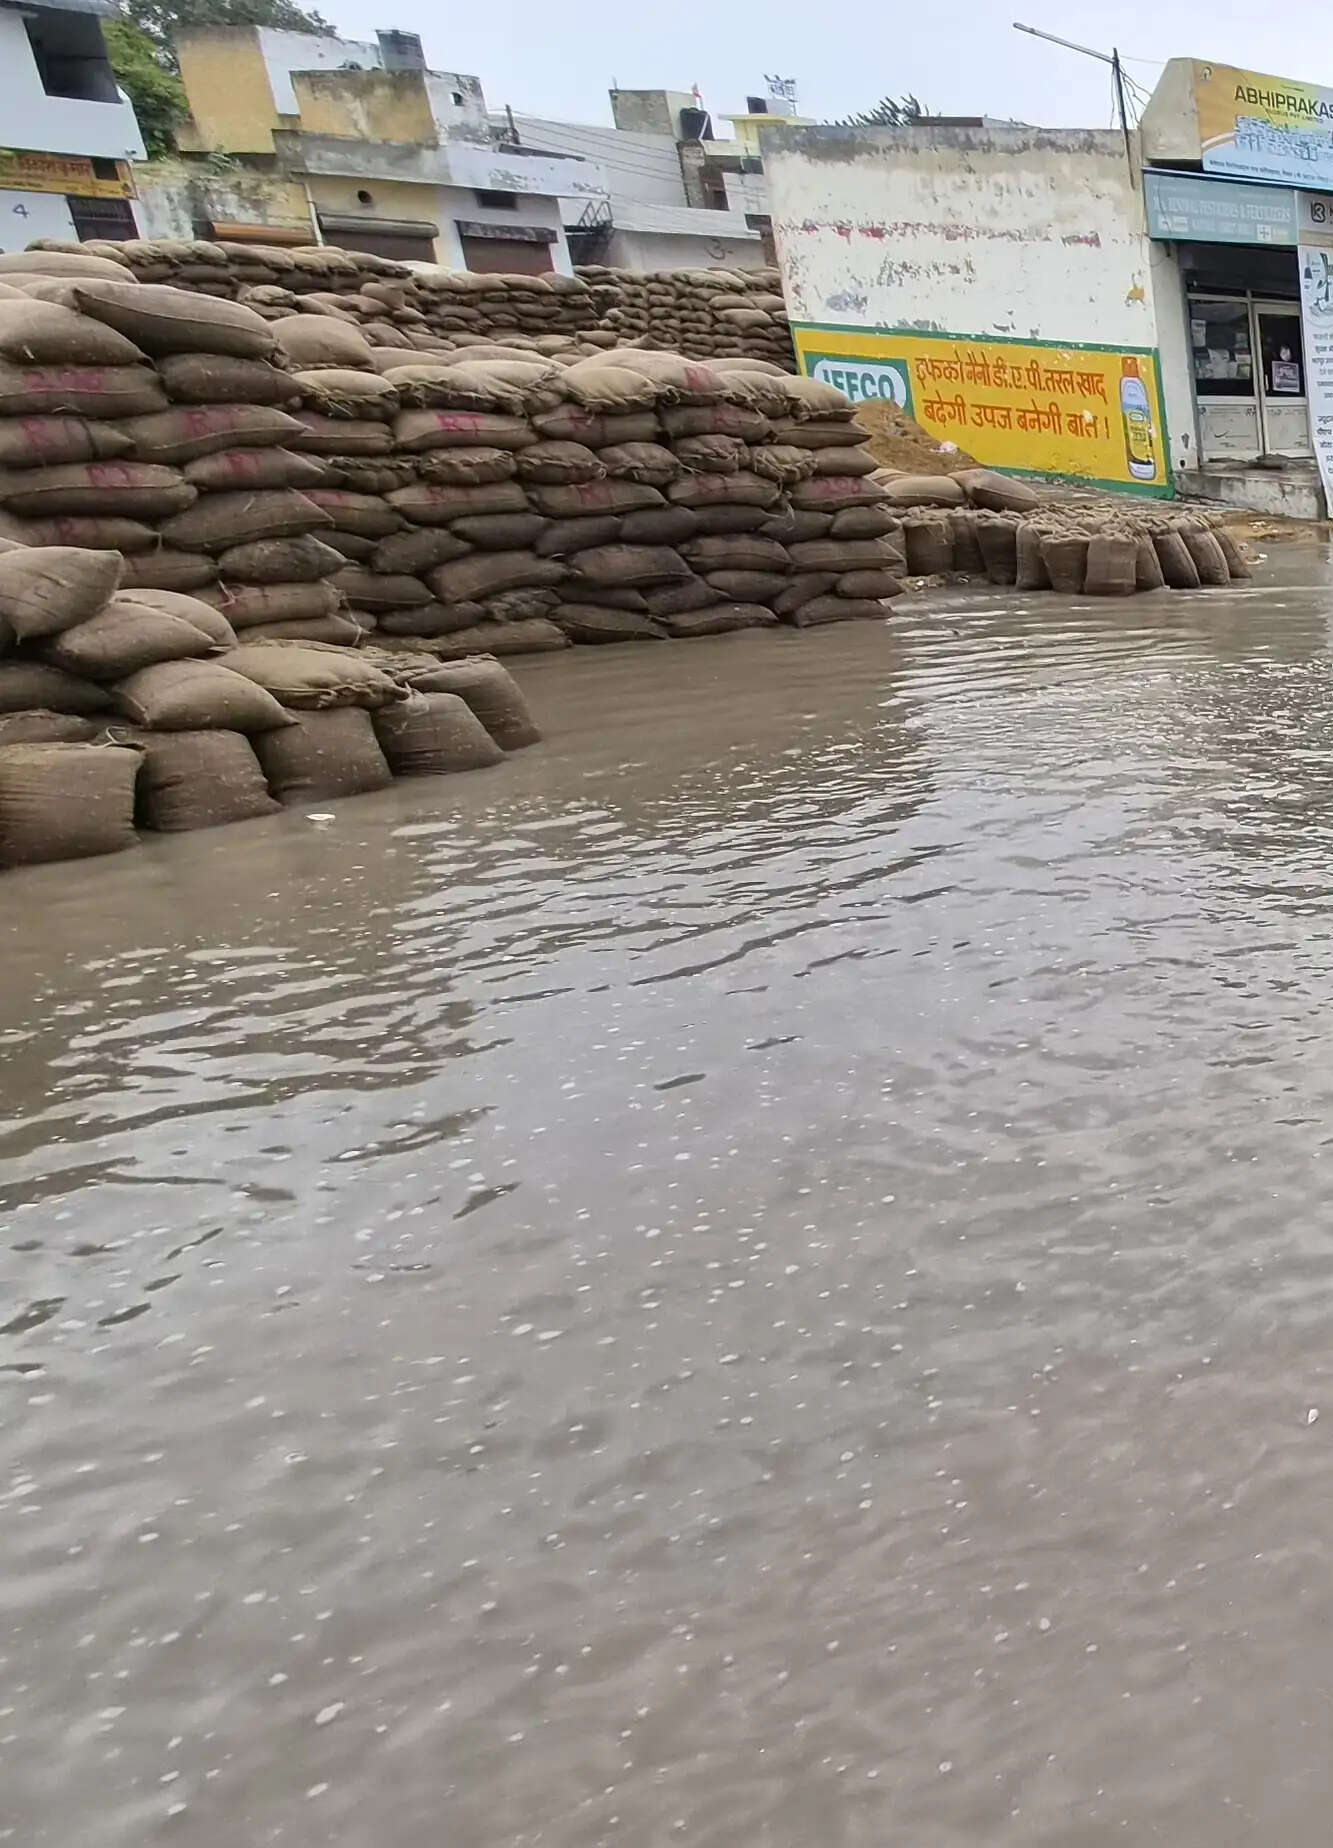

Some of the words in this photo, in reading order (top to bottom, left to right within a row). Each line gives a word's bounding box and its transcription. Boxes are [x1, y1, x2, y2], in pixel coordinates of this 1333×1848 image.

[822, 368, 896, 401] IFFCO
[914, 350, 965, 392] इफको
[966, 350, 991, 387] नैनो
[1077, 370, 1109, 405] खाद
[970, 403, 1012, 430] उपज
[1015, 398, 1062, 435] बनेगी
[1066, 410, 1098, 438] बात
